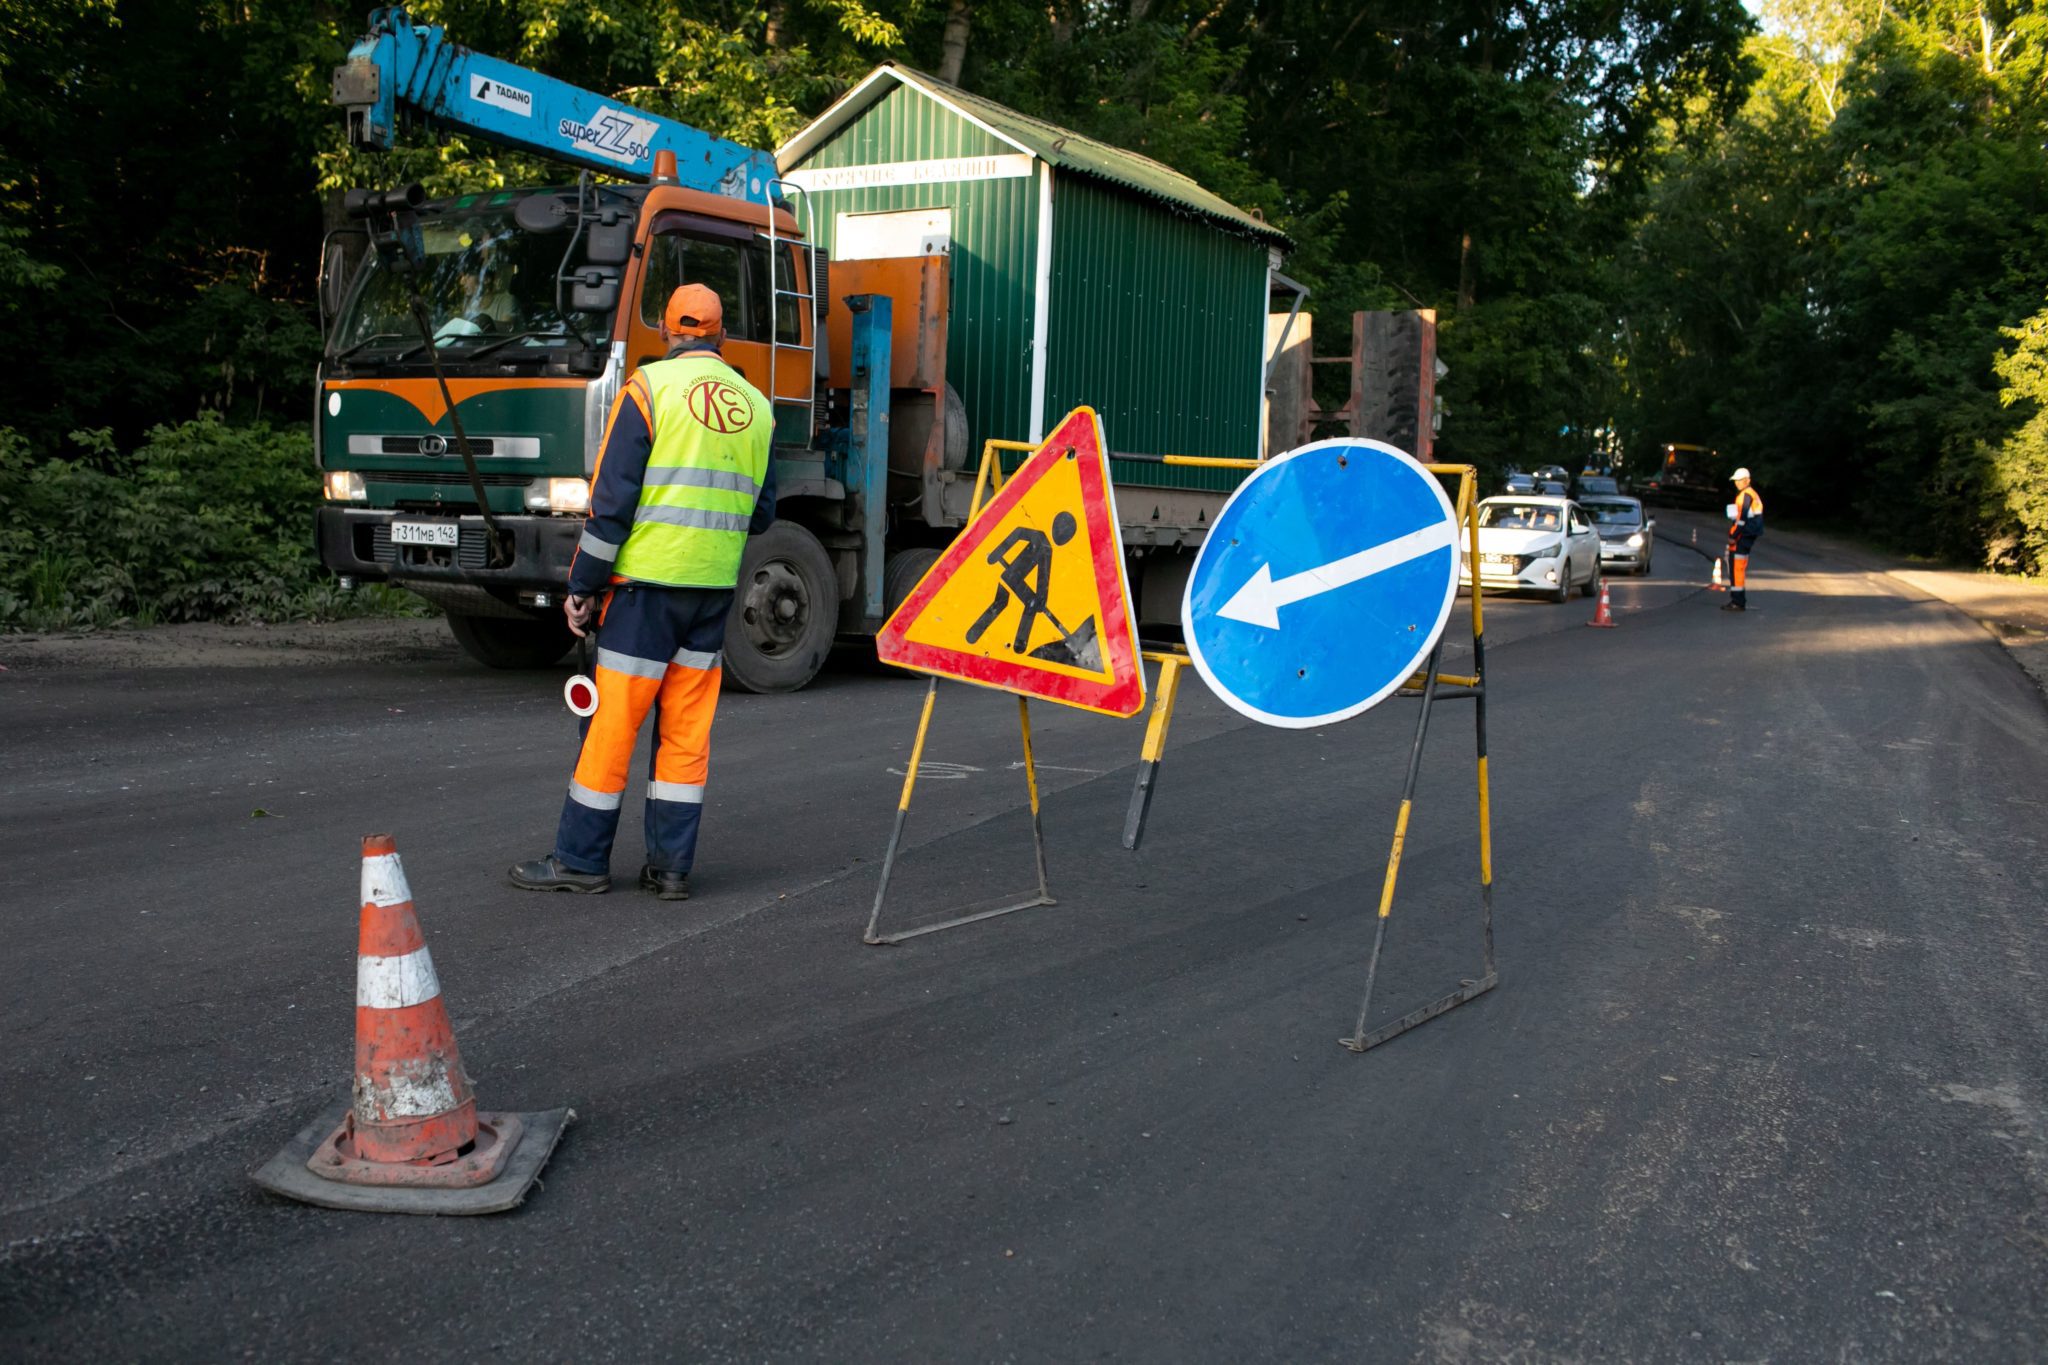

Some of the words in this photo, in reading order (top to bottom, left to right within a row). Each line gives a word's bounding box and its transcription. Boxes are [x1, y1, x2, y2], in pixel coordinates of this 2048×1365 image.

[496, 84, 530, 105] TADANO
[628, 142, 650, 160] 500
[437, 526, 454, 539] 142
